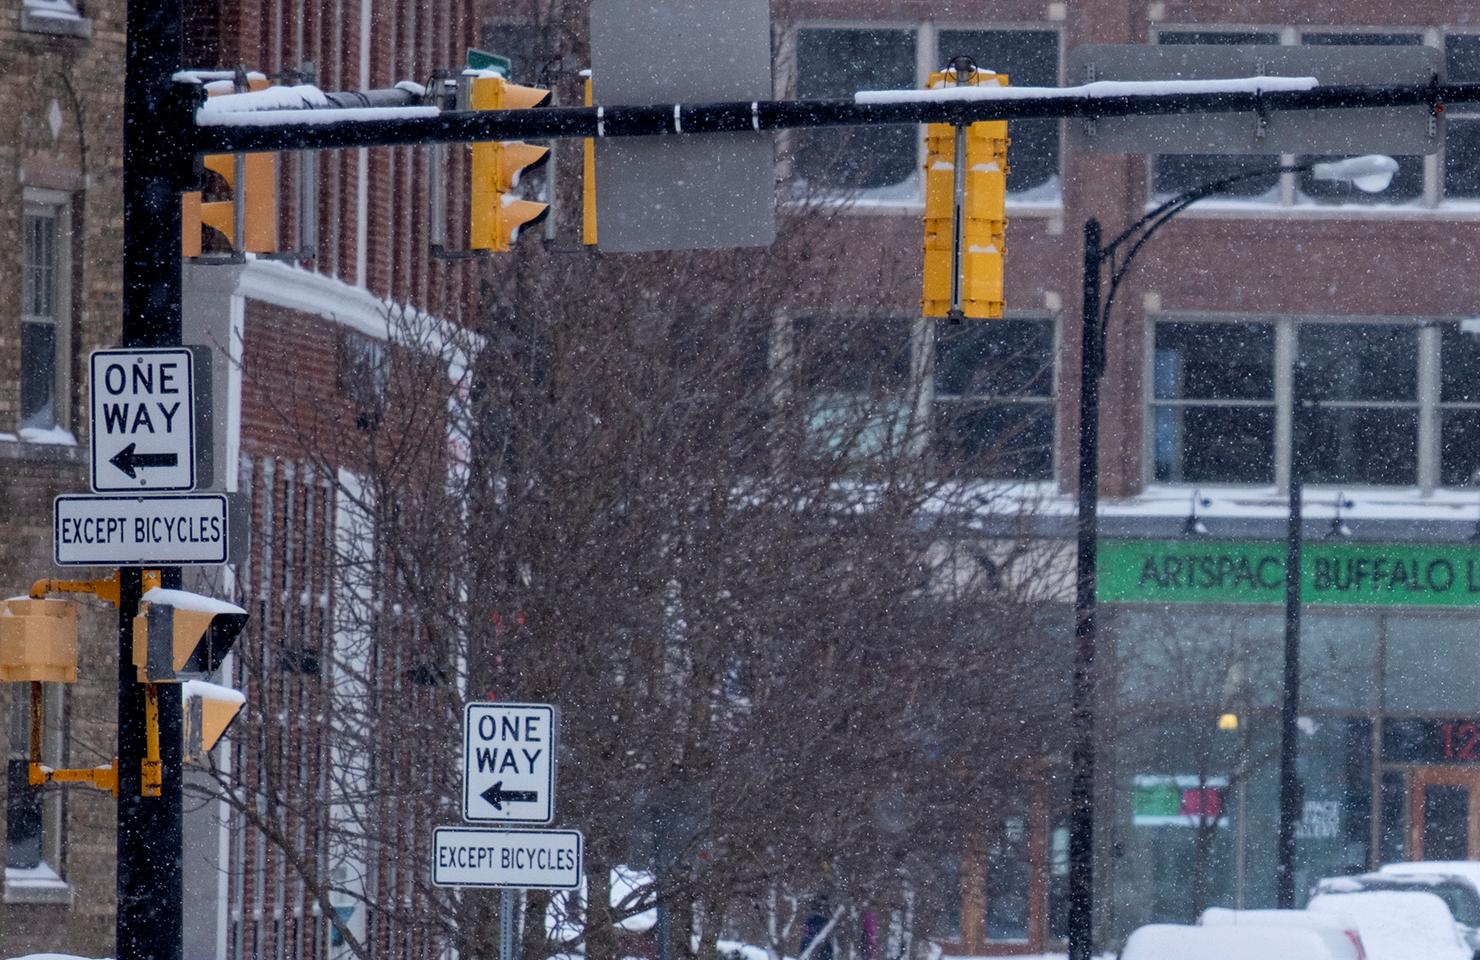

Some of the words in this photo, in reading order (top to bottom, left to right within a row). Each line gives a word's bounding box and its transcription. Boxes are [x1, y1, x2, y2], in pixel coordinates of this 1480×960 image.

[104, 362, 179, 395] ONE
[102, 401, 181, 434] WAY
[61, 517, 127, 543] EXCEPT
[134, 516, 221, 543] BICYCLES
[1138, 555, 1285, 590] ARTSPAC
[1314, 556, 1455, 592] BUFFALO
[478, 715, 541, 742] ONE
[476, 747, 542, 774] WAY
[439, 846, 494, 868] EXCEPT
[501, 848, 574, 870] BICYCLES
